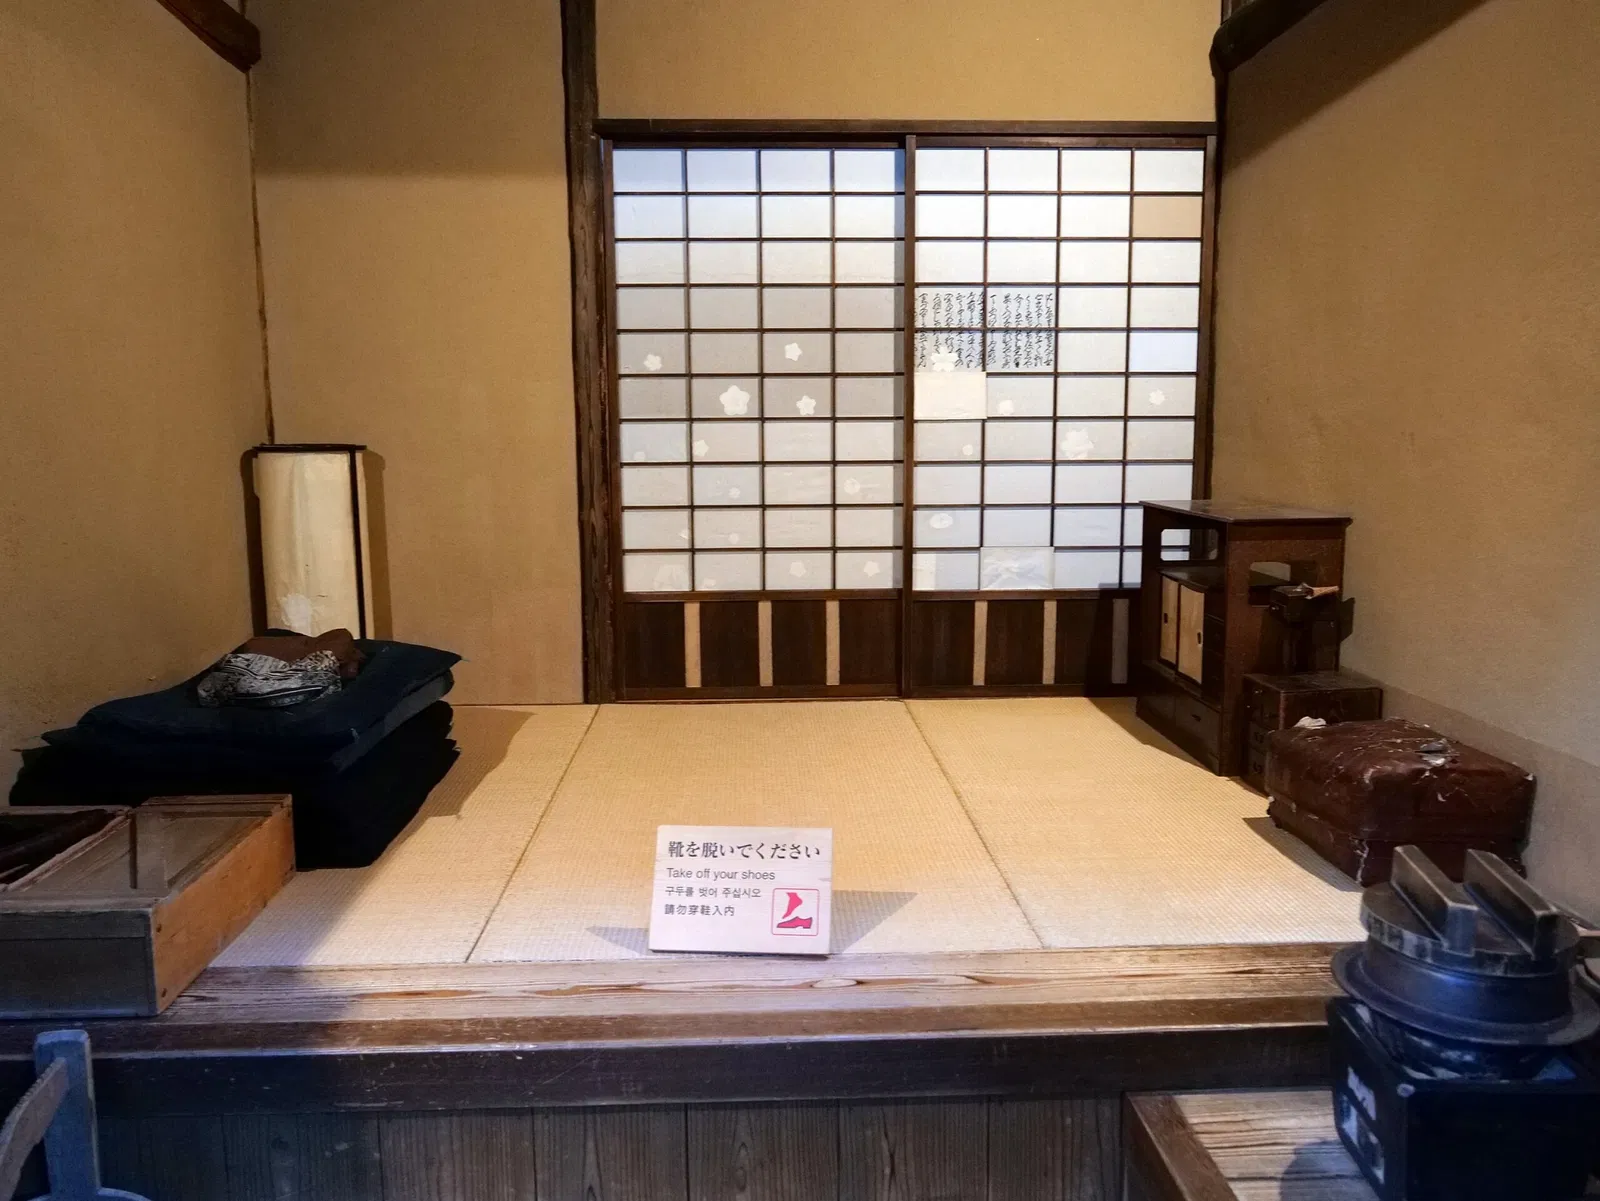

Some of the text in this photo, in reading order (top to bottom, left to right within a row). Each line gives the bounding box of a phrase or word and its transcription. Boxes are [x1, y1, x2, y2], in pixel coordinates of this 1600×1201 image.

[668, 841, 820, 860] 靴を脱いでください
[666, 868, 775, 881] Take off your shoes
[665, 886, 761, 898] 구두를 벗어 주십시오
